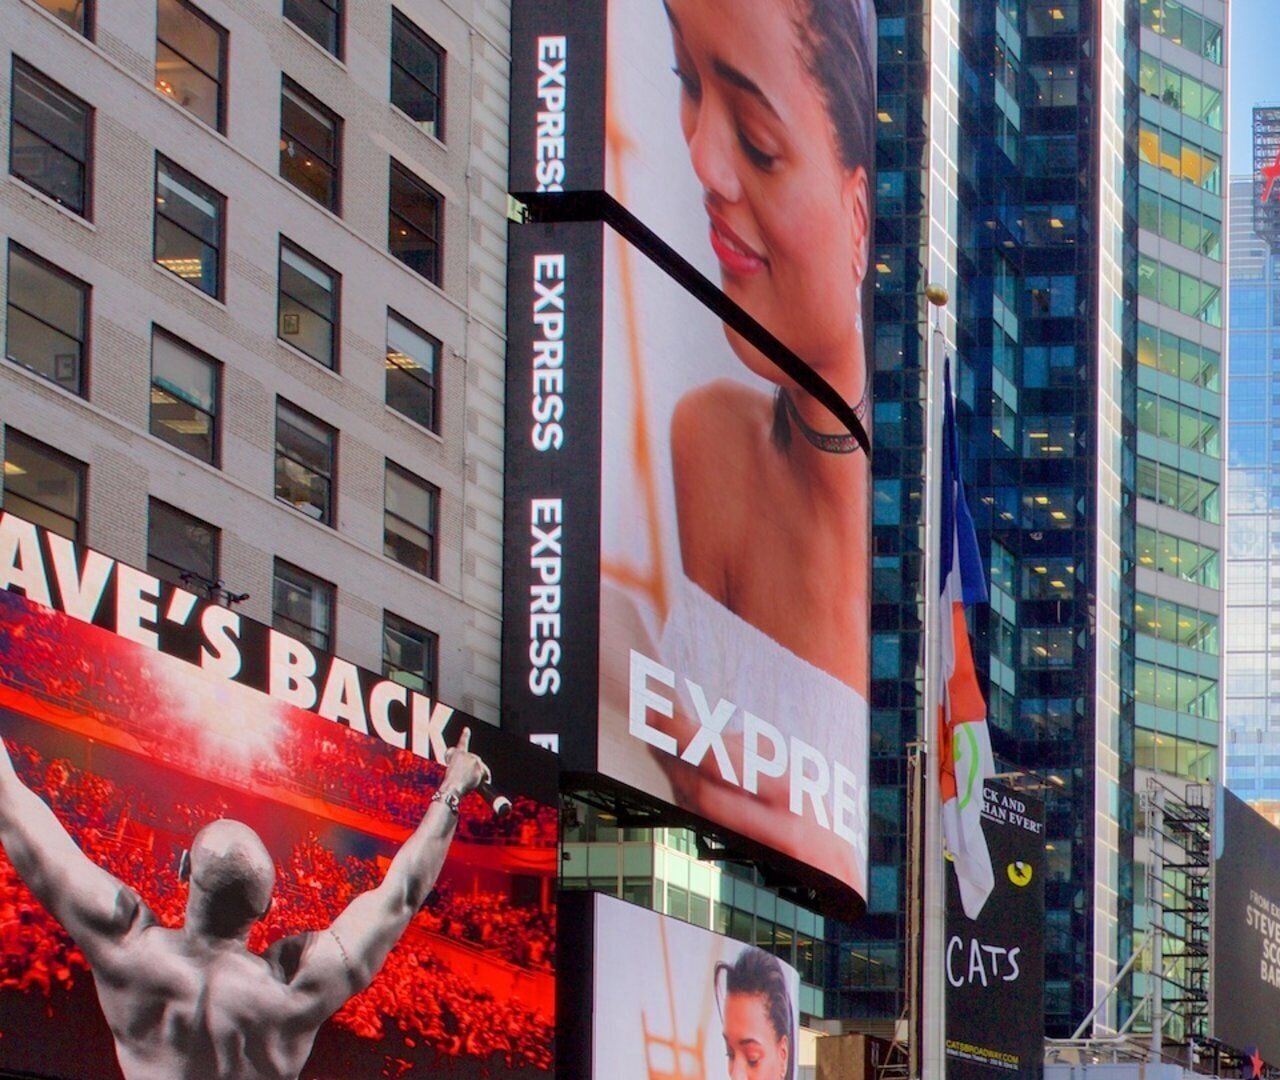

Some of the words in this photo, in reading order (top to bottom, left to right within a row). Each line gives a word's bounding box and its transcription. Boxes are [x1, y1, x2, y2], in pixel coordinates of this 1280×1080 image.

[536, 36, 566, 193] EXPRES
[532, 254, 565, 452] EXPRESS
[529, 498, 563, 697] EXPRESS
[268, 636, 455, 764] BACK
[984, 801, 1006, 820] HAN
[1001, 796, 1025, 813] AND
[945, 936, 1021, 987] CATS
